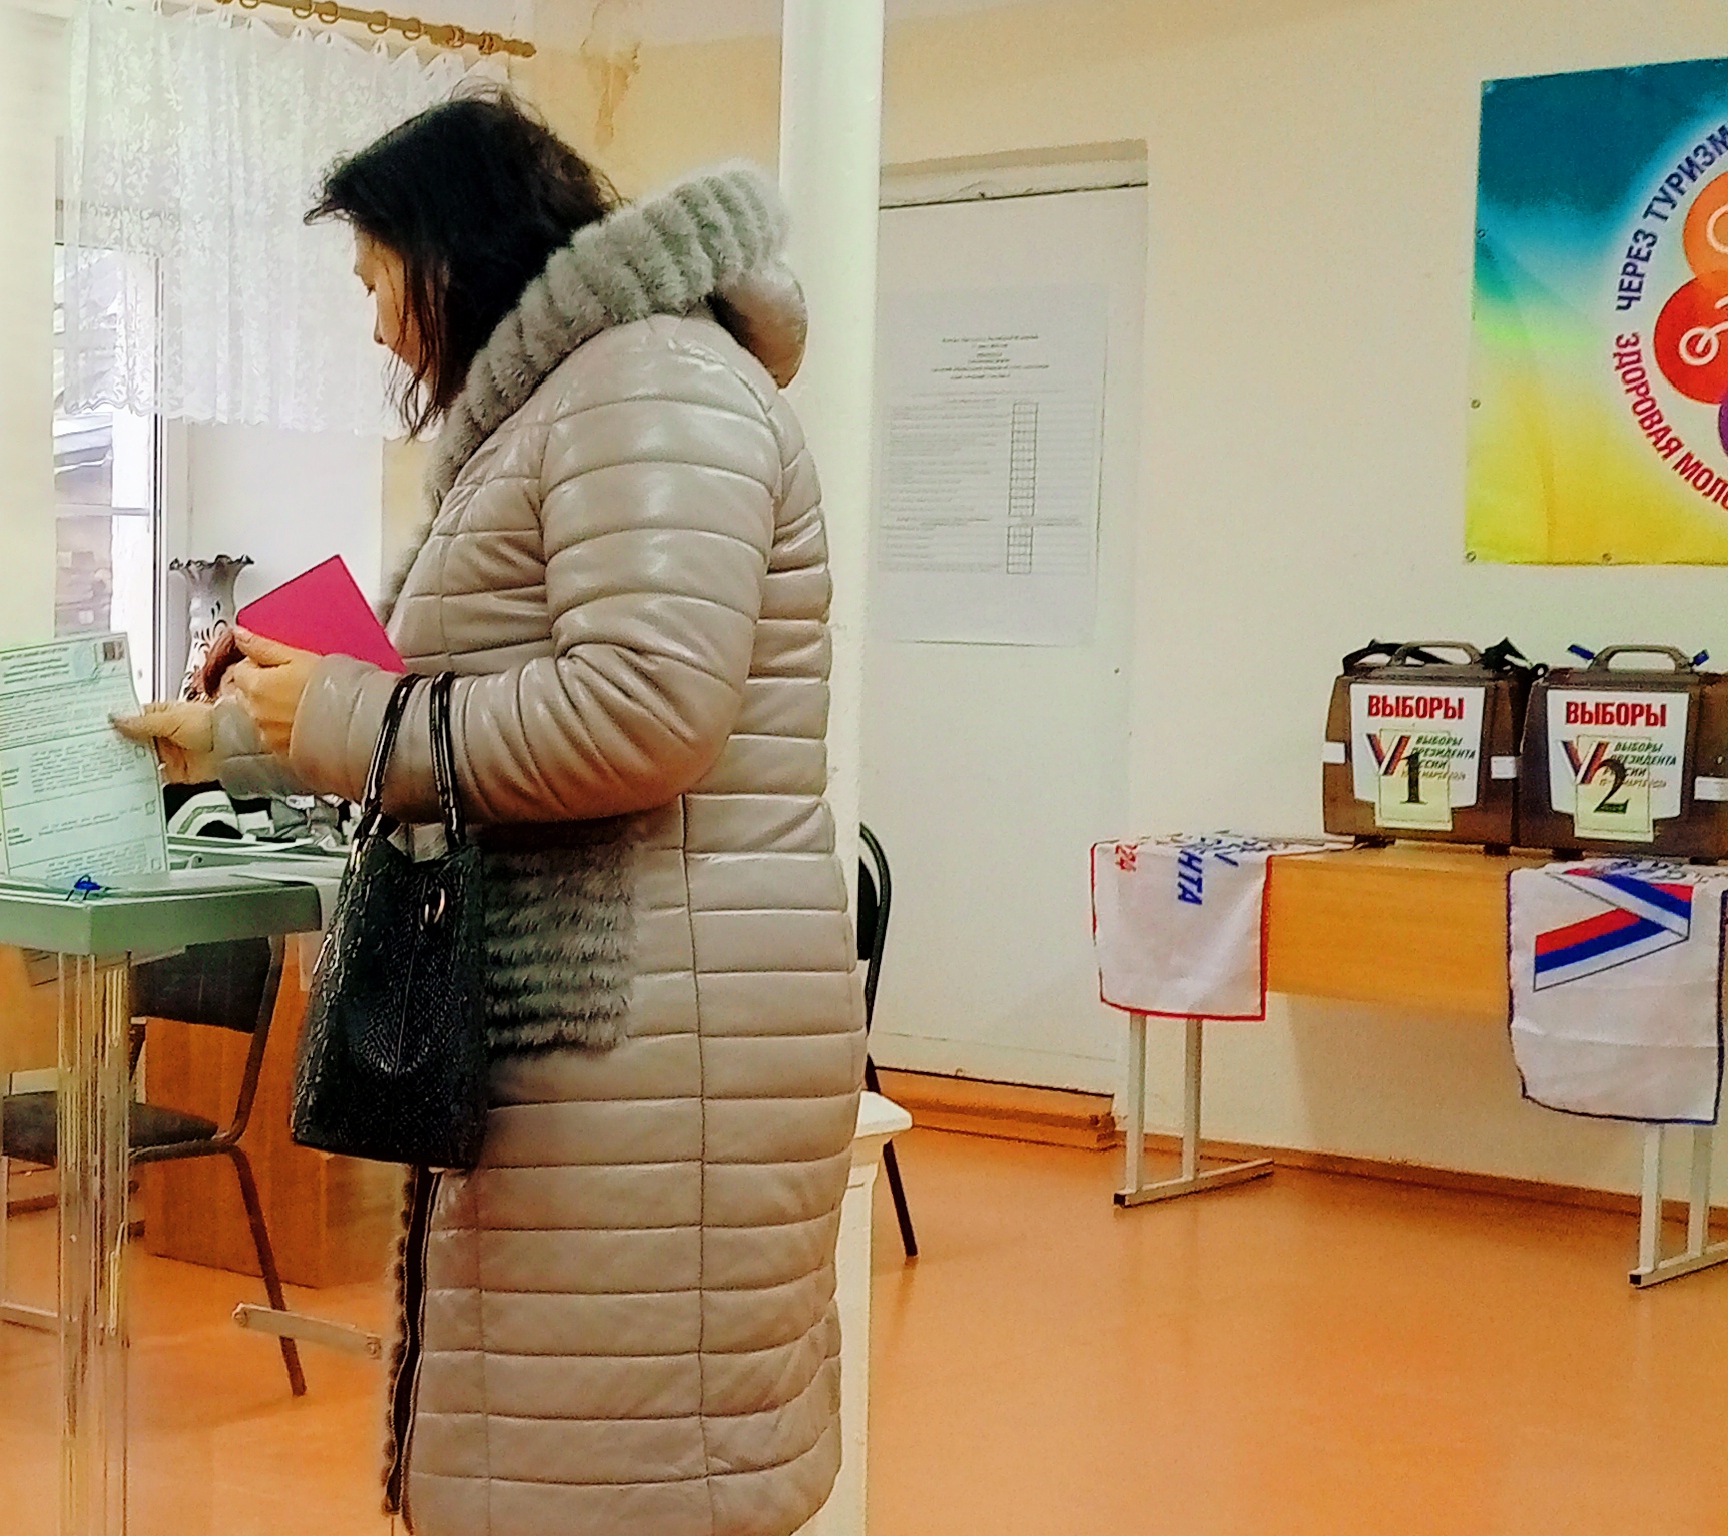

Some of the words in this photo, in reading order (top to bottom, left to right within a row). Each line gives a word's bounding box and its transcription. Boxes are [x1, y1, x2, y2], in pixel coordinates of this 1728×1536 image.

[1615, 227, 1658, 312] ЧЕРЕЗ
[1612, 331, 1684, 461] ЗДОРОВАЯ
[1368, 695, 1464, 720] ВЫБОРЫ
[1566, 701, 1667, 727] ВЫБОРЫ
[1399, 752, 1428, 804] 1
[1594, 758, 1629, 814] 2
